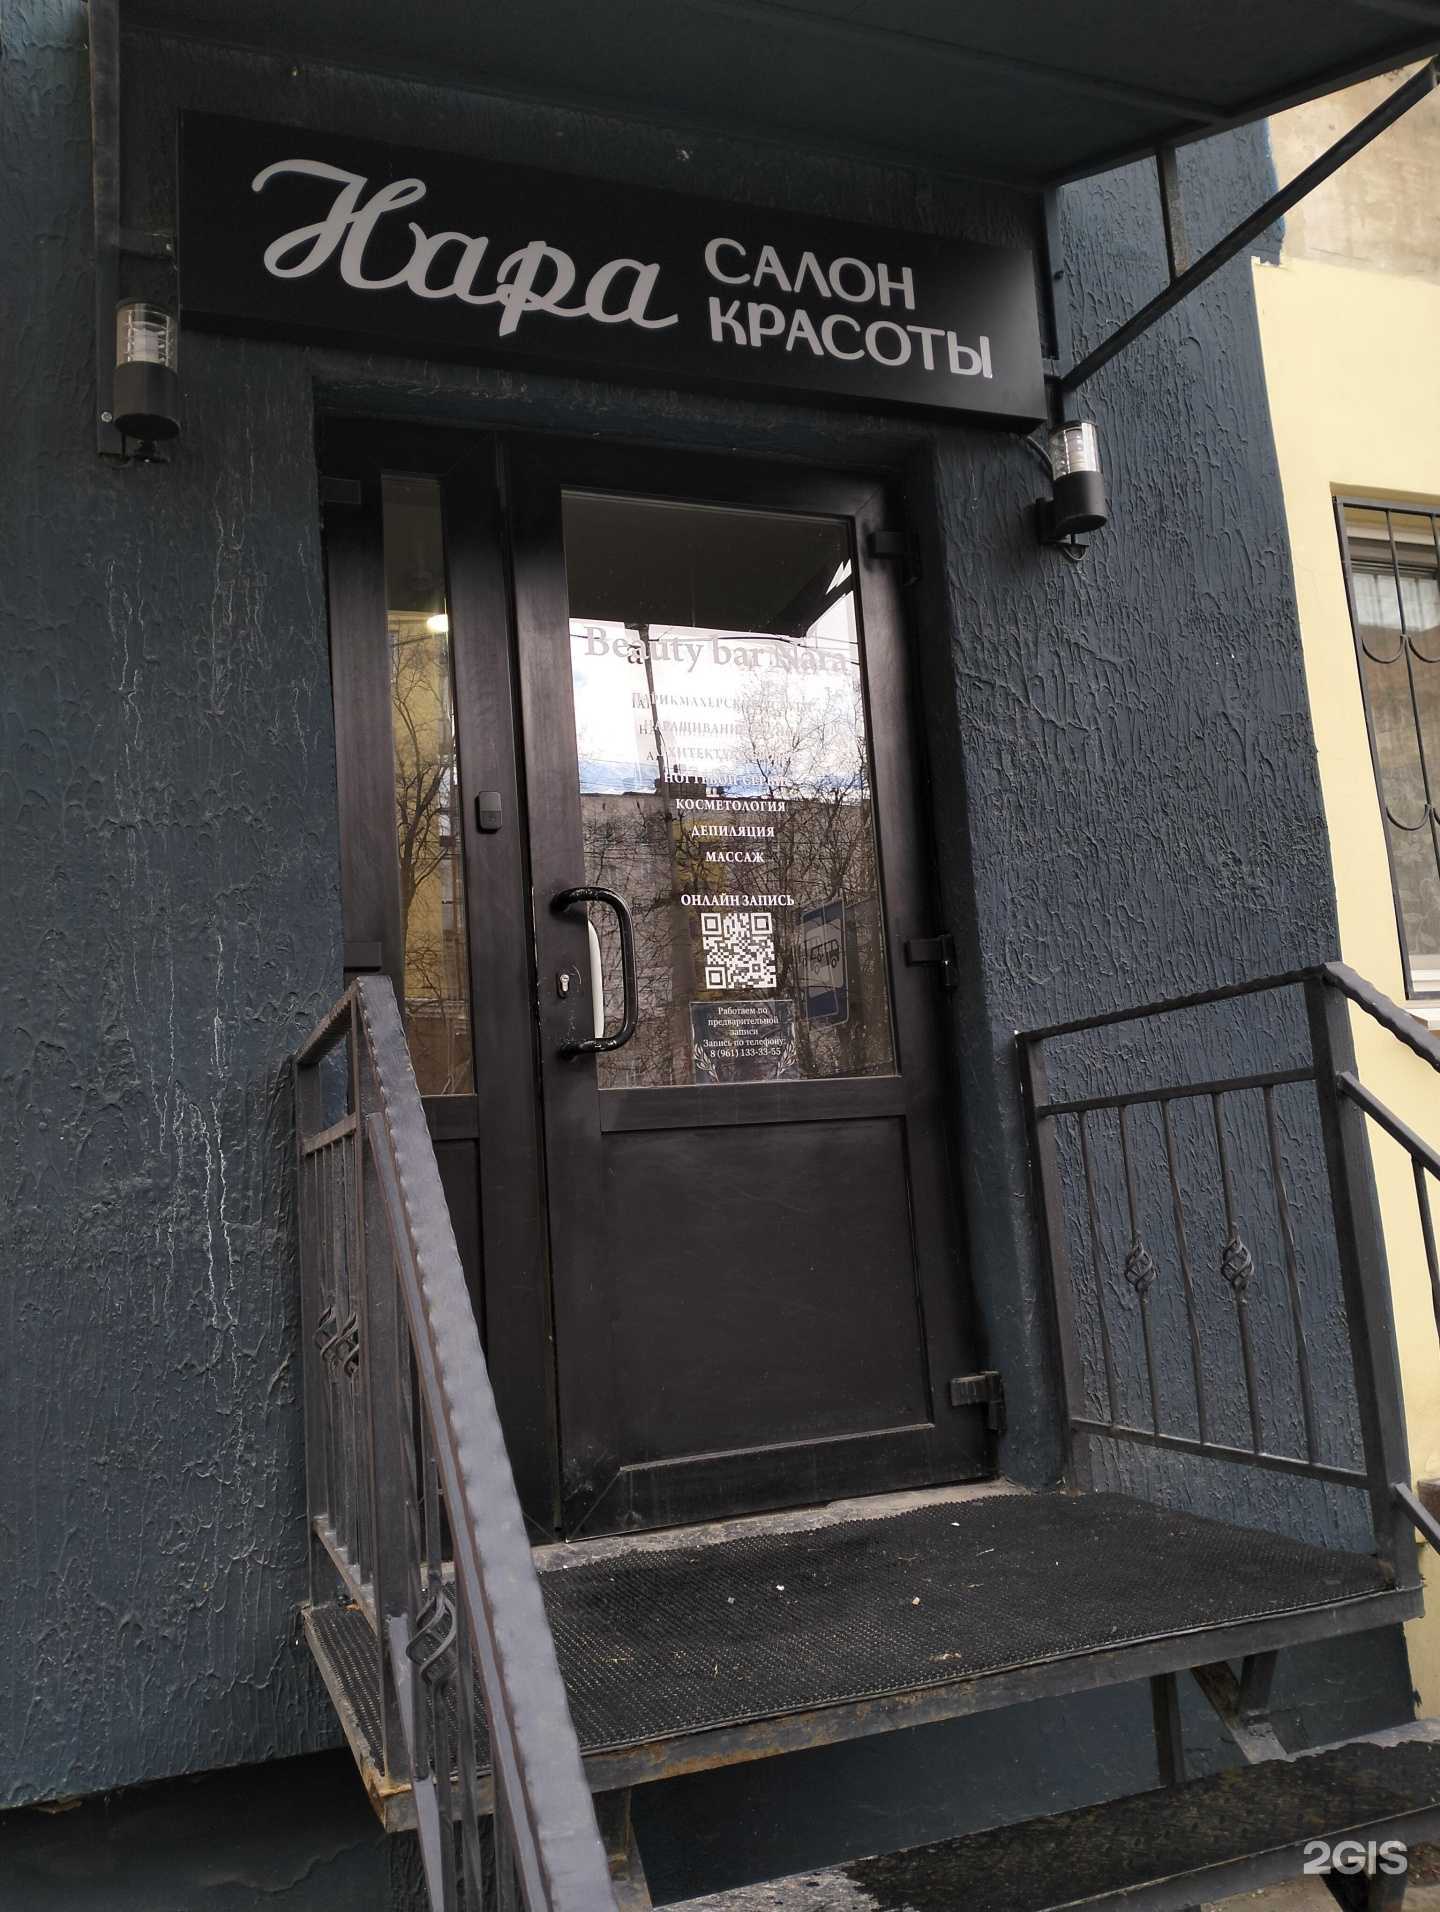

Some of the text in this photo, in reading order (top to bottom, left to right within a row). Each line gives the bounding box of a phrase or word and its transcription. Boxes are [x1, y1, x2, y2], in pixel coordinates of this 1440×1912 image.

[251, 158, 678, 337] Нара
[703, 237, 916, 311] САЛОН
[708, 296, 994, 380] КРАСОТЫ
[584, 626, 704, 672] Beauty
[712, 637, 761, 669] bar
[676, 798, 786, 812] КОСМЕТОЛОГИЯ
[691, 825, 775, 839] ДЕПИЛЯЦИЯ
[706, 851, 765, 863] МАССАЖ
[681, 893, 795, 906] ОНЛАЙН ЗАПИСЬ
[718, 1007, 756, 1015] Работаем
[708, 1016, 779, 1027] предварительной
[729, 1028, 758, 1036] записи
[703, 1039, 732, 1047] Запись
[734, 1039, 744, 1047] по
[710, 1048, 781, 1058] 8 (961) 133-33-55
